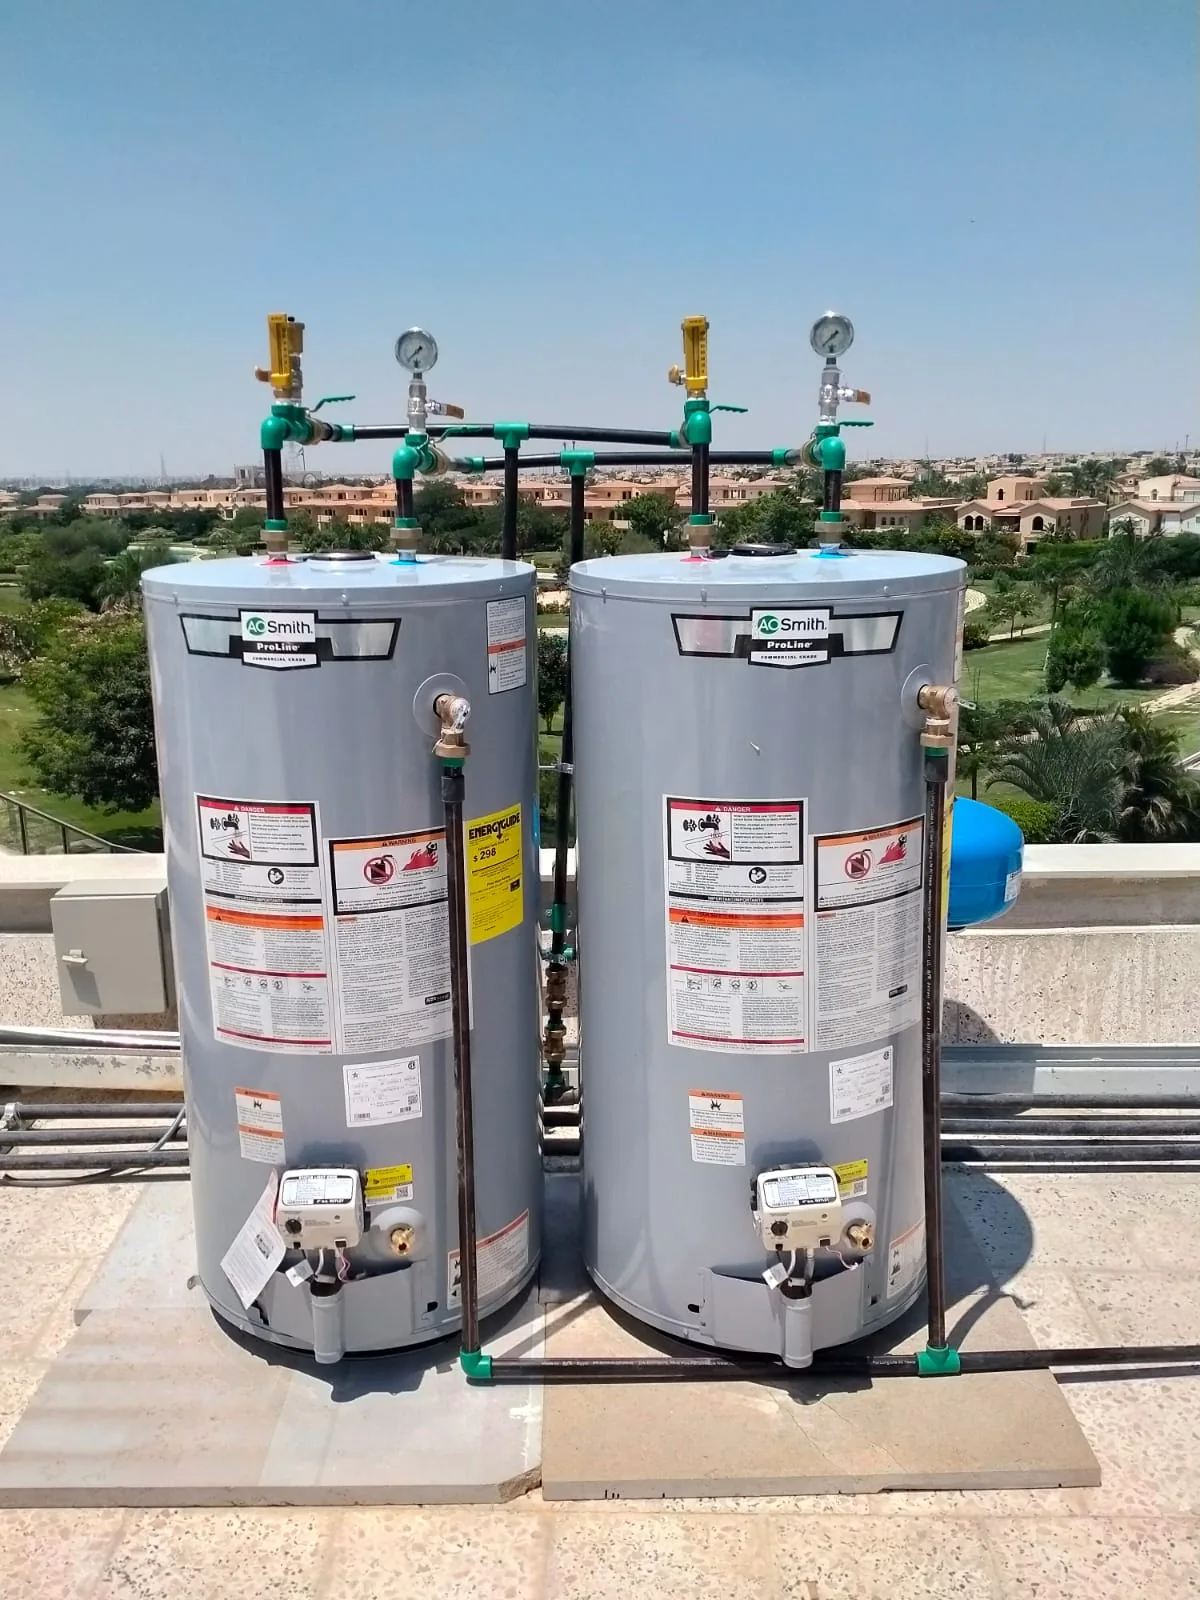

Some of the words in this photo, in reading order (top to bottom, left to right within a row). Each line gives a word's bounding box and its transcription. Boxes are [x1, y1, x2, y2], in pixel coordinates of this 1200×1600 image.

[267, 620, 311, 634] Smith
[781, 618, 825, 631] Smith
[256, 642, 299, 652] ProLine
[766, 640, 812, 650] ProLine
[469, 812, 520, 840] ENERGYGUIDE
[479, 847, 497, 860] 298
